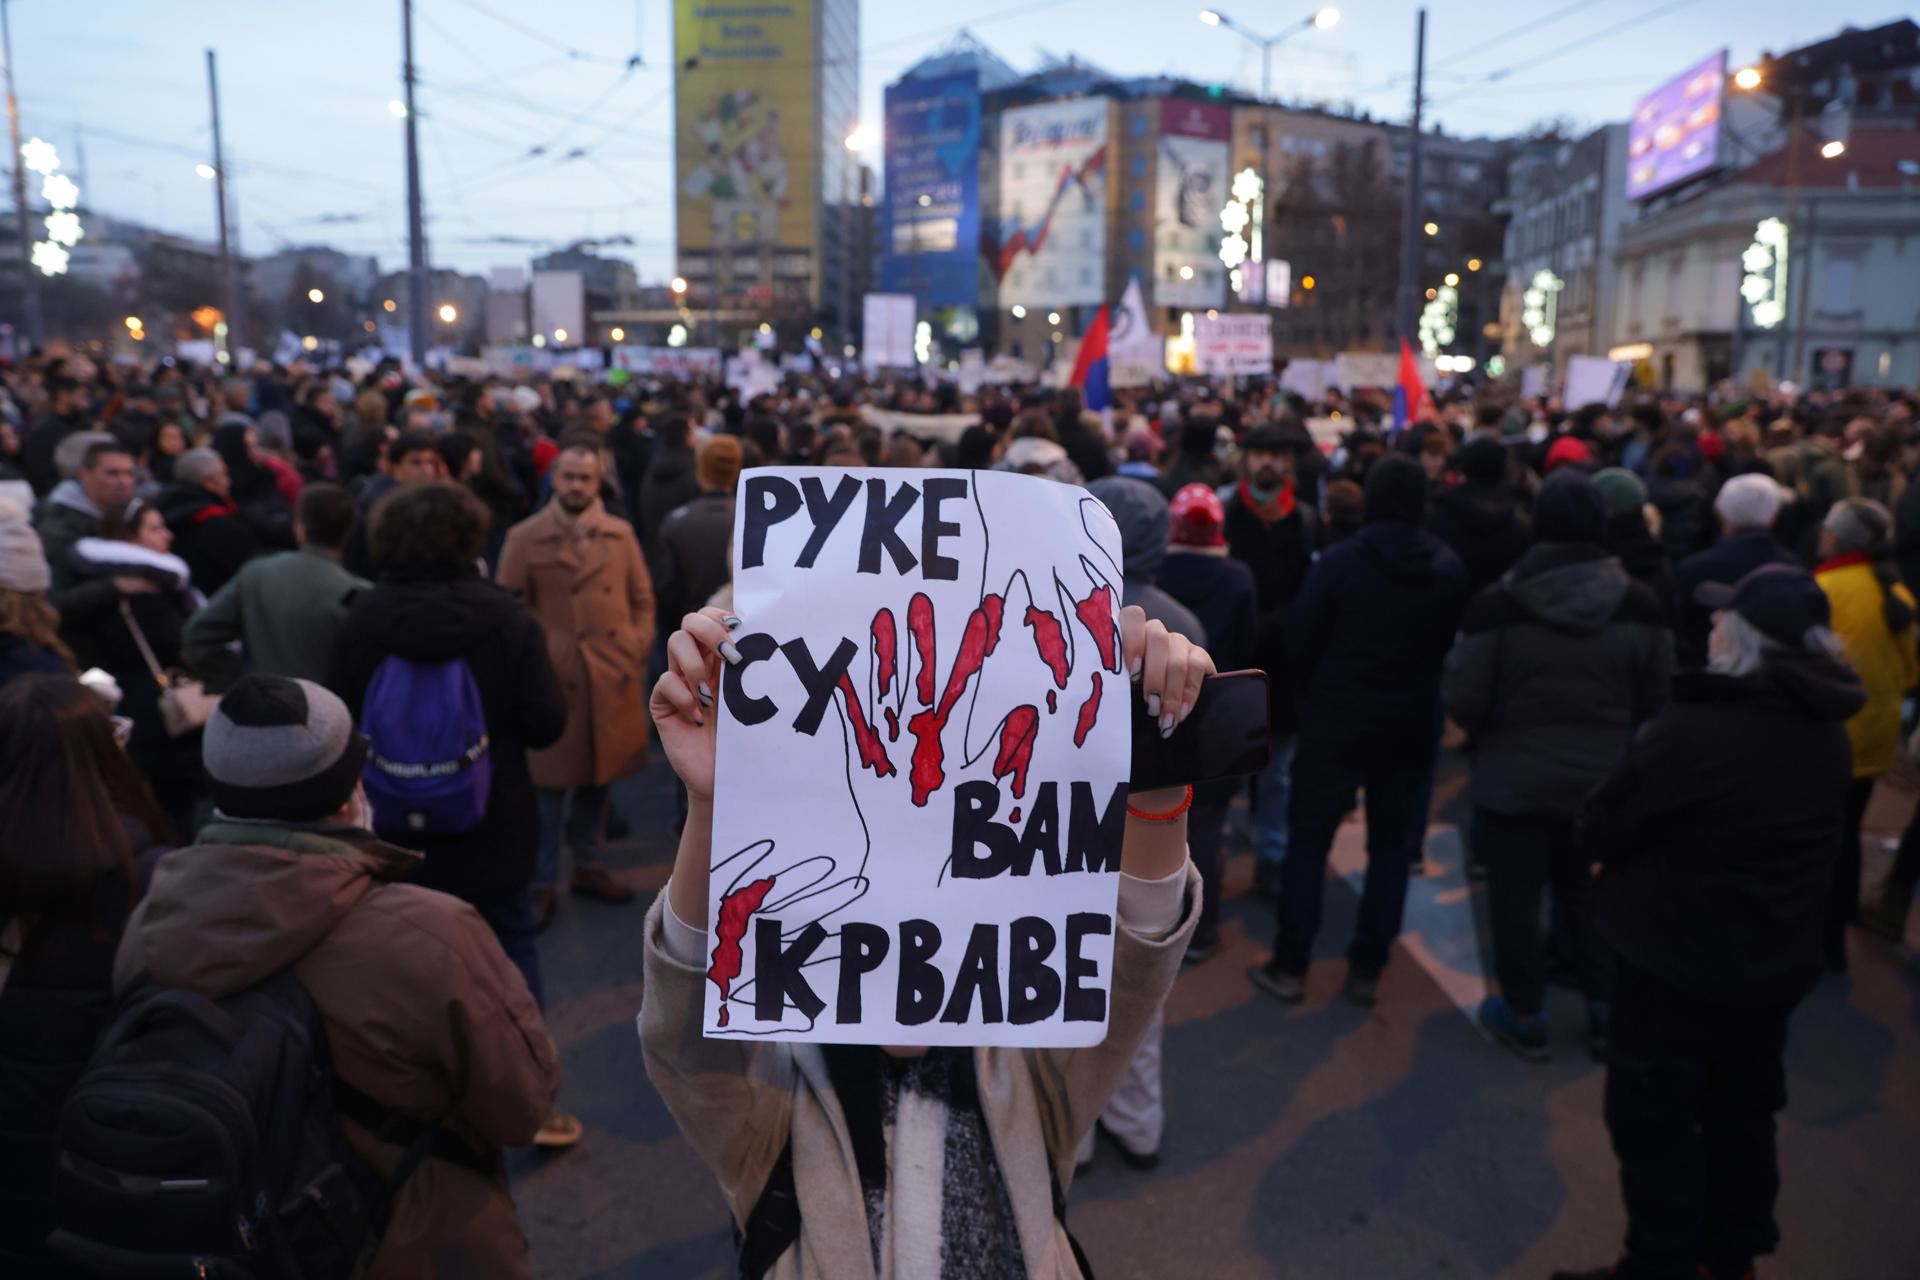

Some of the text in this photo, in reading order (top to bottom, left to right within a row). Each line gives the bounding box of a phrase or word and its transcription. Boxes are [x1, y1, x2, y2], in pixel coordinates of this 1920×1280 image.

[742, 474, 968, 581] РУКЕ
[723, 632, 859, 737] СУ
[951, 780, 1130, 879] ВАМ
[755, 912, 1112, 1025] КРВАВЕ
